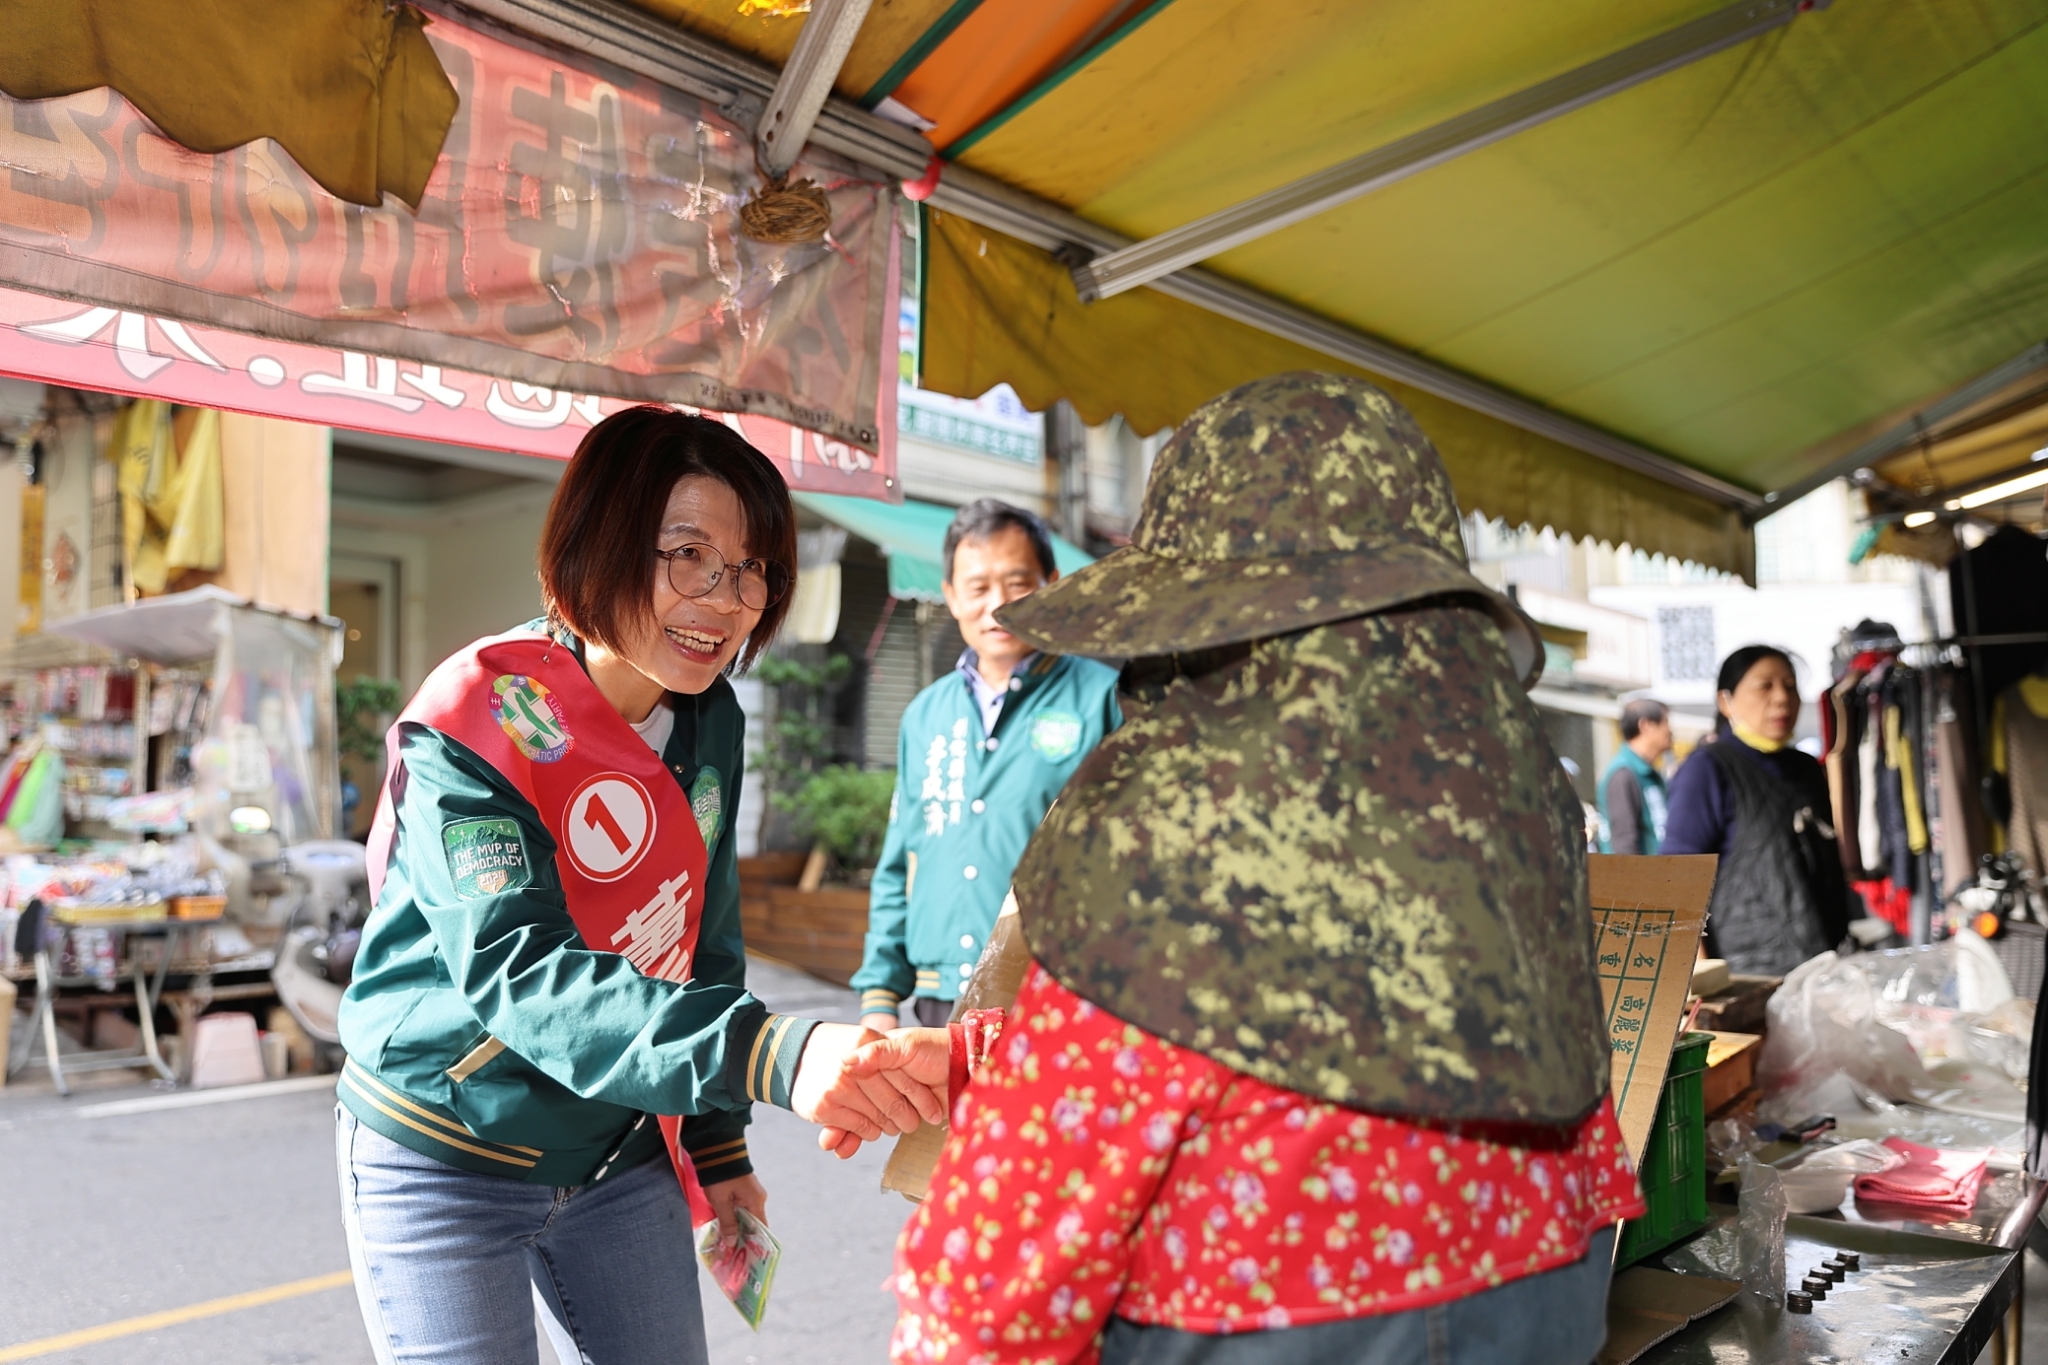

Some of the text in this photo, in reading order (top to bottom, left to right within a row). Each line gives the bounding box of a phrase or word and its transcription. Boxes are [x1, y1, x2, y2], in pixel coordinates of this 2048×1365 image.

[510, 730, 553, 761] DEMOCRATIC
[547, 697, 566, 723] PARTY
[584, 792, 632, 856] 1
[454, 842, 520, 865] THE MVP OF
[456, 855, 523, 879] DEMOCRACY
[479, 872, 505, 885] 2024
[1611, 922, 1663, 1055] 品名 高麗菜
